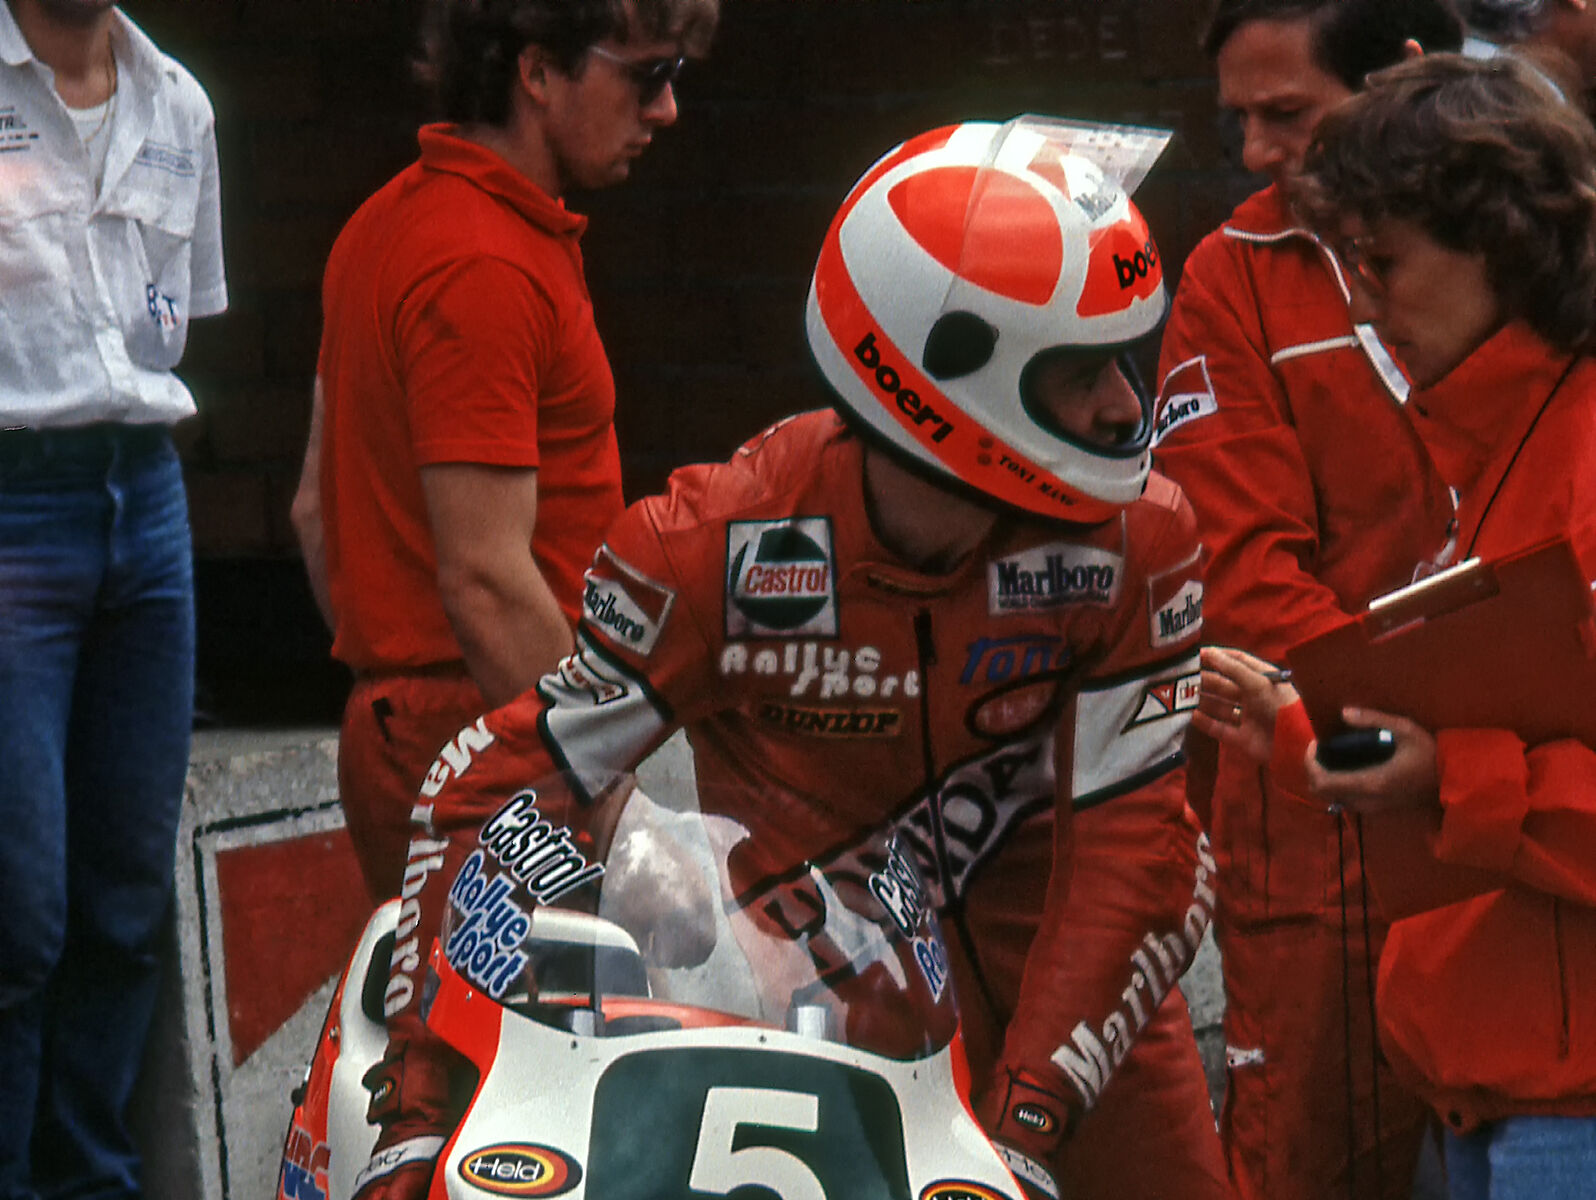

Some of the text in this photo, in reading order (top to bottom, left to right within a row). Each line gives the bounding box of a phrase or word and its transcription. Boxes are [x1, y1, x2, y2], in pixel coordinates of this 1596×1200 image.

[744, 563, 829, 594] Castrol
[996, 554, 1114, 597] Marlboro
[761, 703, 898, 734] DUNLOP
[478, 788, 606, 906] Castrol
[449, 848, 531, 952] Rallye
[446, 910, 529, 998] Sport
[468, 1157, 541, 1181] Held
